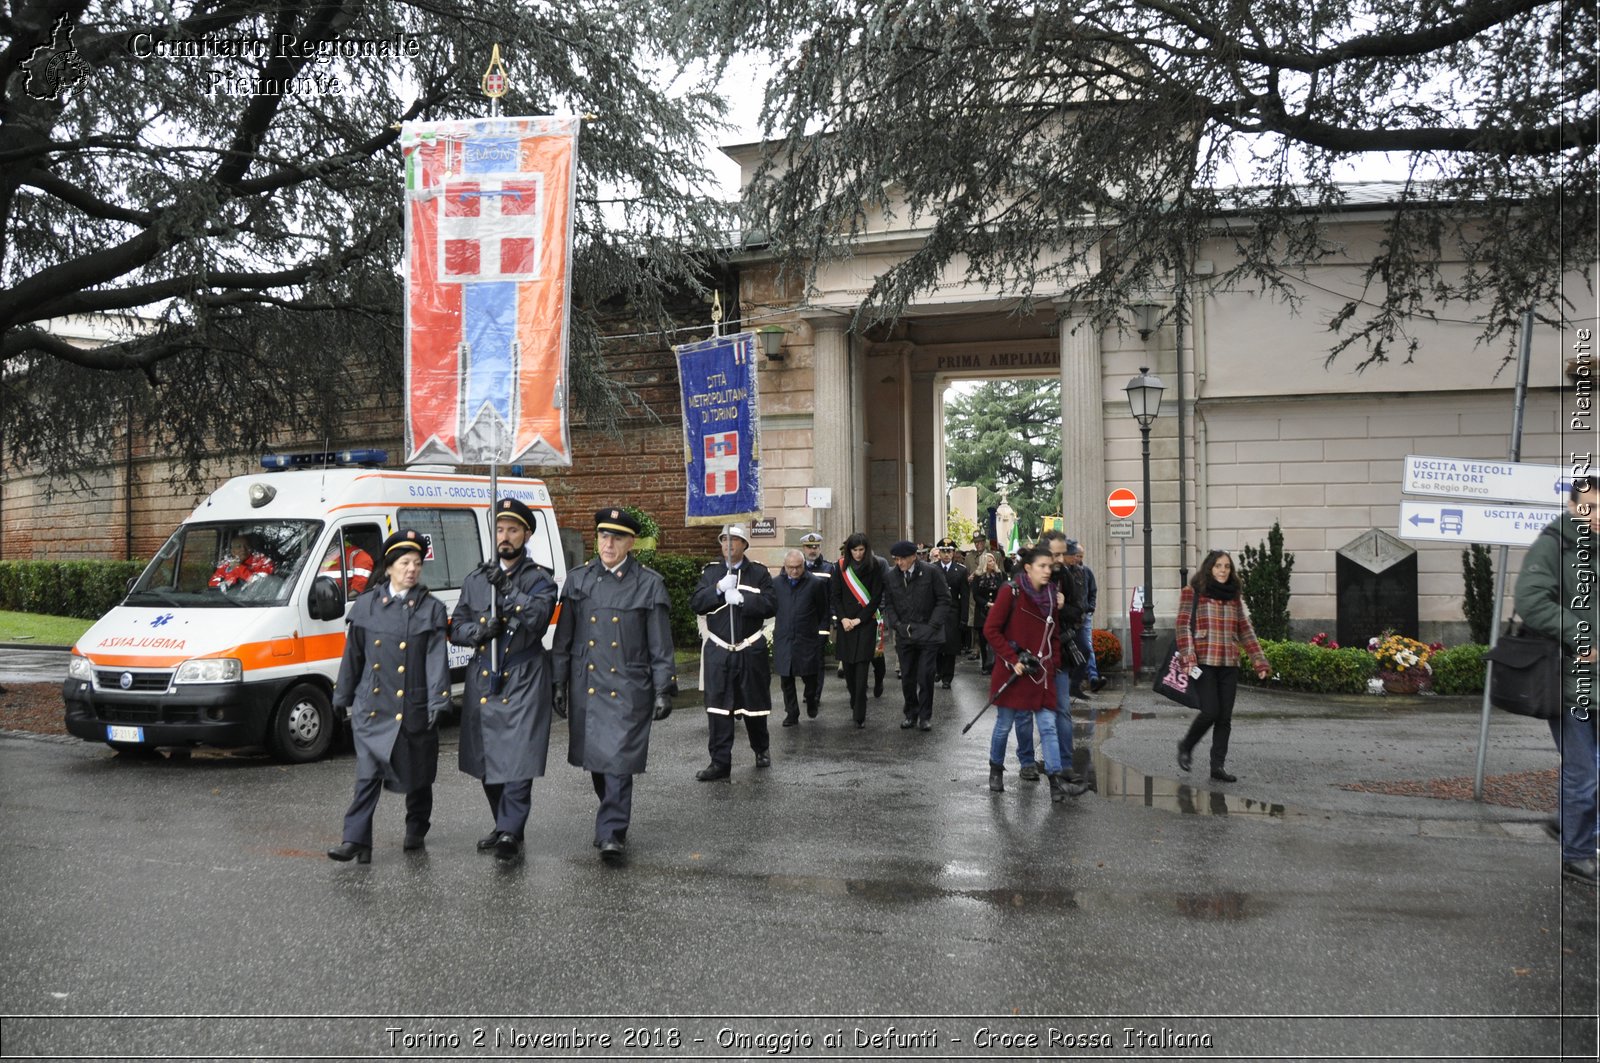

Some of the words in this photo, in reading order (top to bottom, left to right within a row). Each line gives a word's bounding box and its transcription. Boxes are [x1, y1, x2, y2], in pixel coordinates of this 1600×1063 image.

[937, 354, 981, 368] PRIMA
[989, 351, 1061, 366] AMPLIAZI
[702, 410, 709, 423] DI
[710, 406, 738, 421] TORINO
[1413, 460, 1457, 472] USCITA
[1463, 463, 1513, 476] VEICOLI
[1413, 470, 1485, 484] VISITATORI
[449, 487, 477, 498] CROCE
[477, 488, 486, 498] DI
[486, 488, 502, 499] SN
[502, 489, 535, 500] GIOVANNI
[1411, 481, 1431, 490] C.so
[1434, 483, 1460, 493] Regio
[1462, 484, 1489, 494] Parco
[1484, 509, 1524, 519] USCITA
[1514, 521, 1521, 530] E
